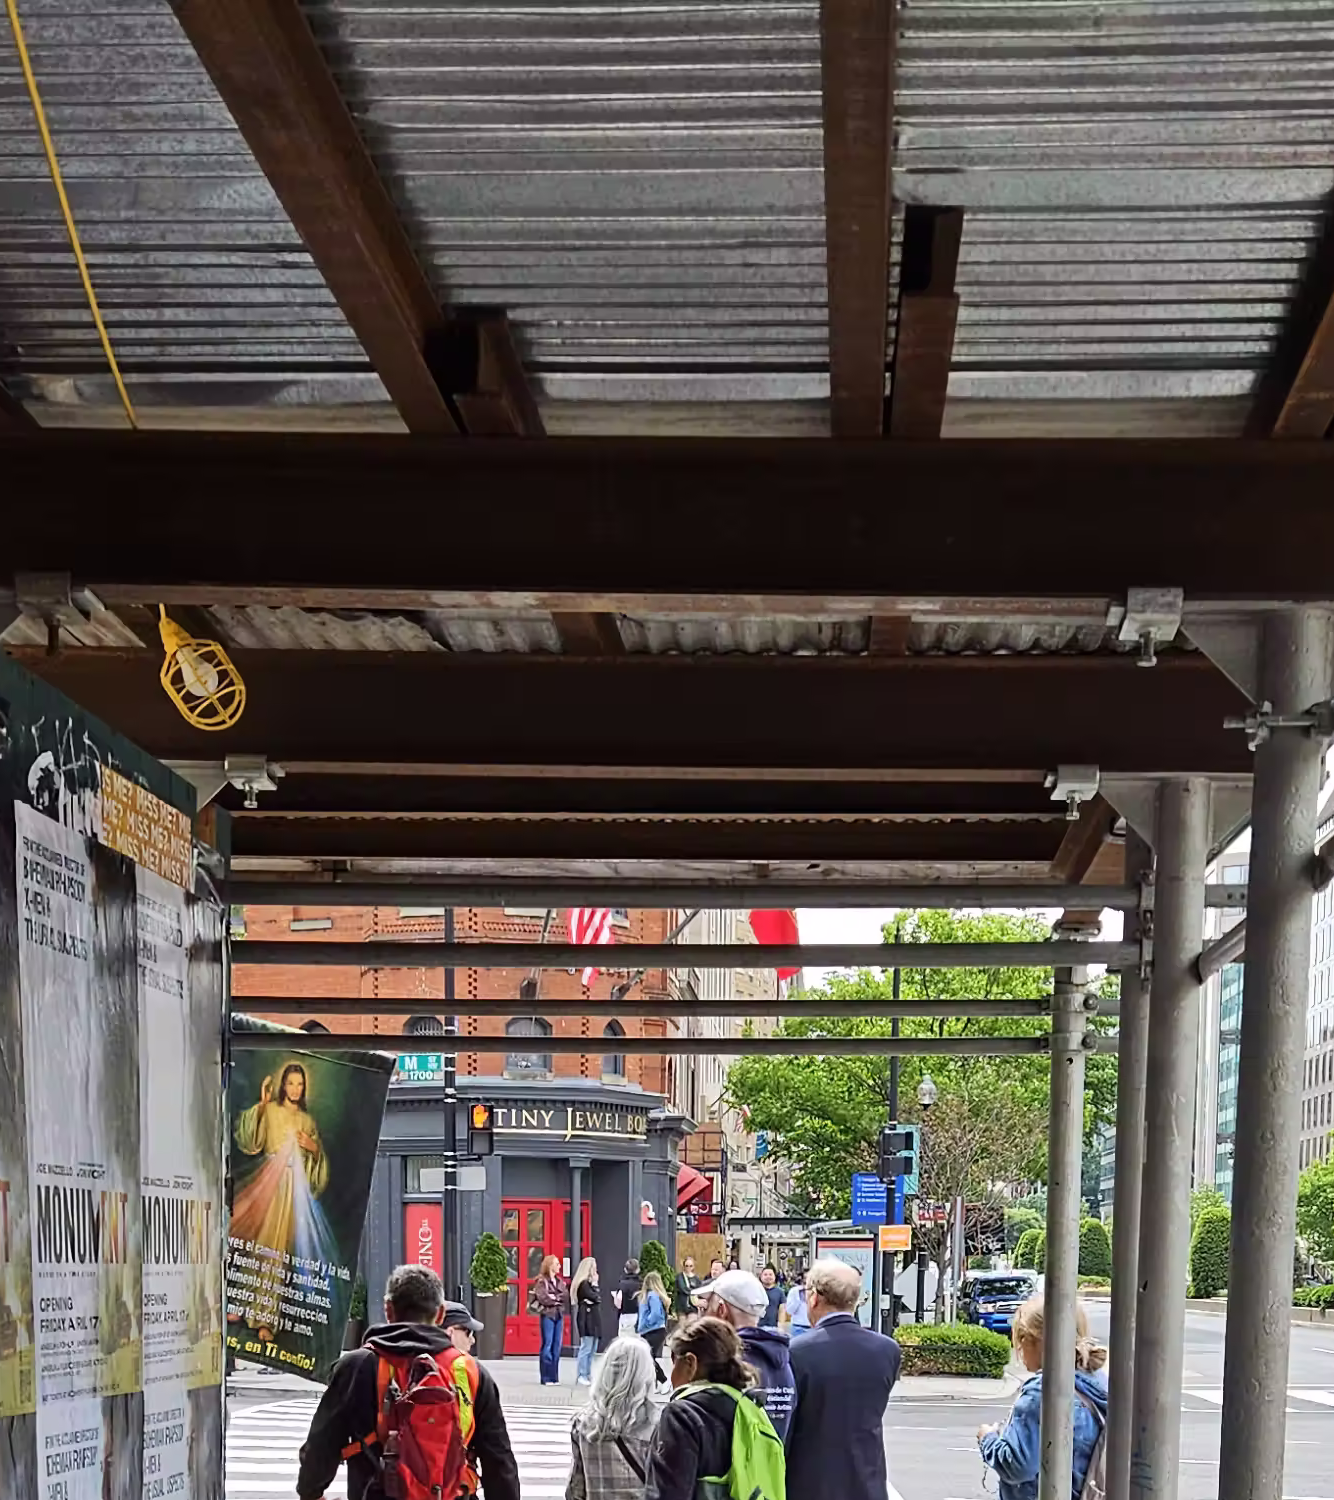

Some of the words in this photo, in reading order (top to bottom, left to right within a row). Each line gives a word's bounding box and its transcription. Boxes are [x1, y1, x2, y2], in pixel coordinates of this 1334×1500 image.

[405, 1056, 418, 1070] M
[410, 1071, 433, 1080] 1700
[494, 1109, 554, 1128] TINY
[565, 1108, 622, 1141] JEWEL
[37, 1185, 128, 1264] MONUMENT
[142, 1196, 211, 1264] MONUMENT
[246, 1240, 254, 1251] el
[292, 1256, 320, 1272] verdad
[328, 1262, 335, 1276] la
[233, 1252, 260, 1270] fuente
[292, 1272, 330, 1291] santidad.
[306, 1291, 331, 1309] almas.
[293, 1323, 314, 1337] amo.
[245, 1341, 261, 1353] en
[265, 1343, 278, 1357] Ti
